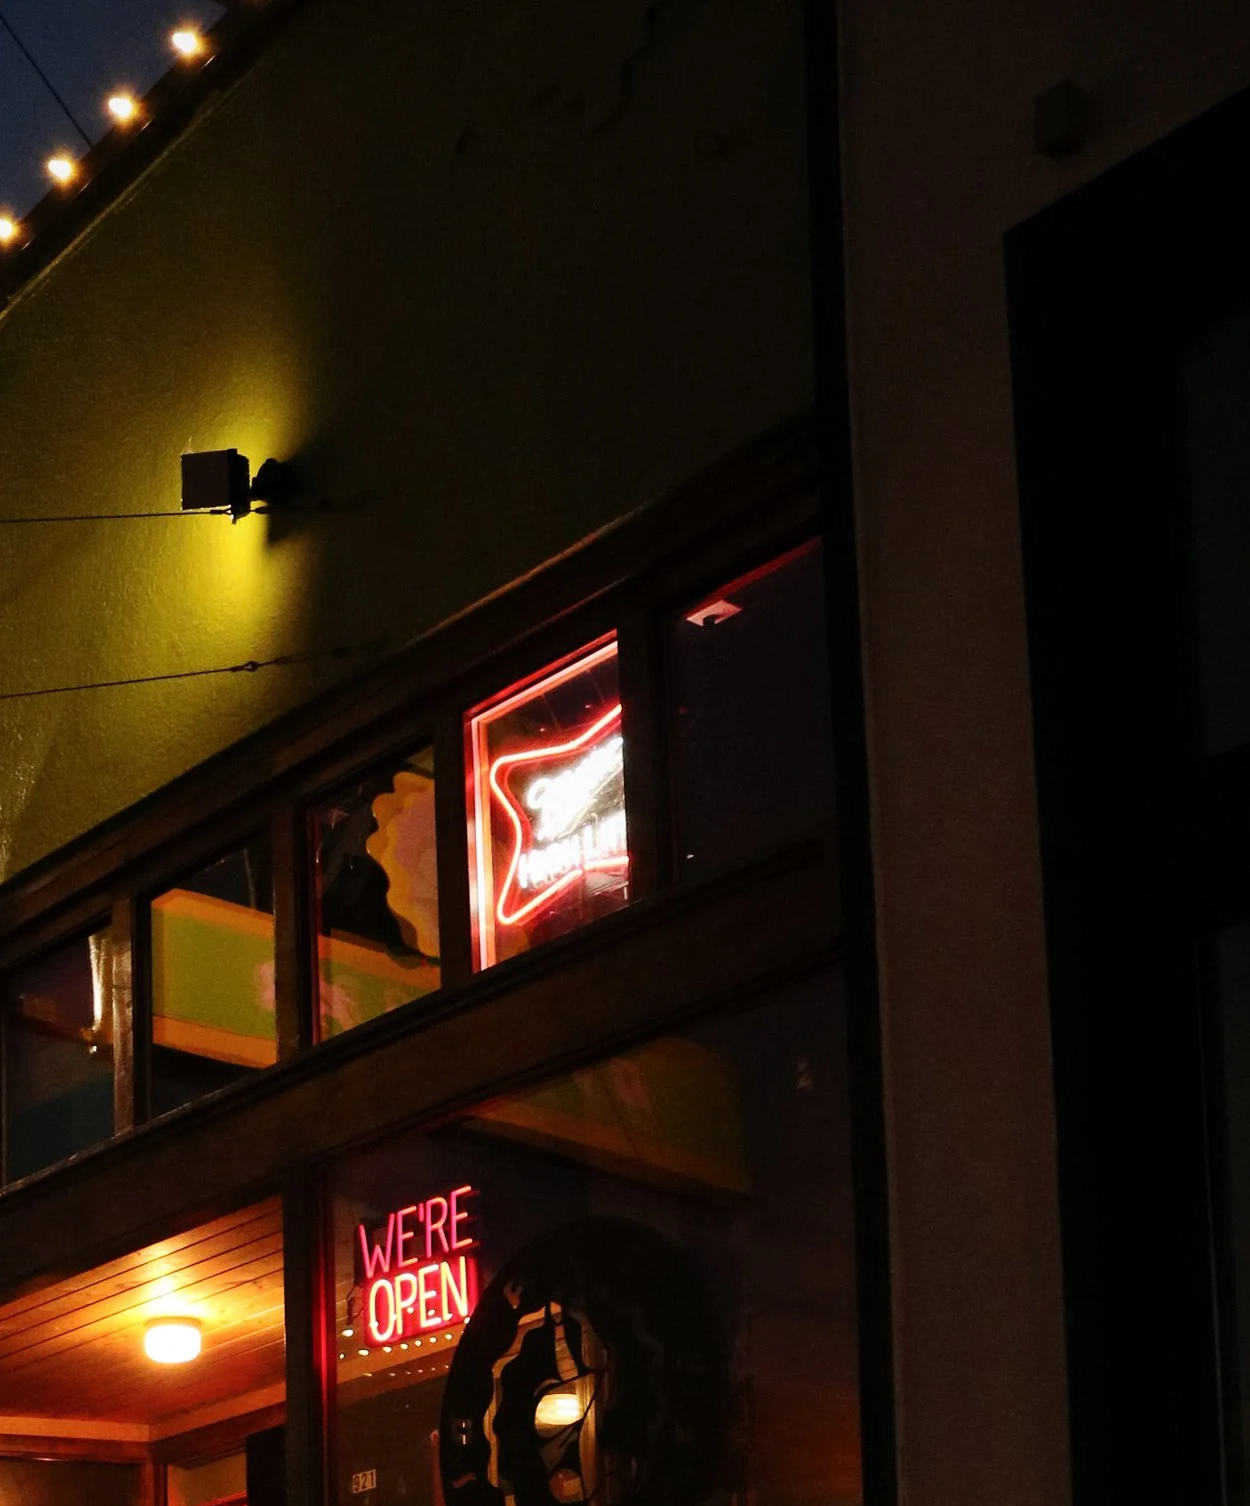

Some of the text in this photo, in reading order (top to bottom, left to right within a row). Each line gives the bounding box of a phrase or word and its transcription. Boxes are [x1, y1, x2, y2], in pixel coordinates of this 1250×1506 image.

[359, 1185, 473, 1279] WE'RE
[369, 1256, 469, 1342] OPEN
[353, 1470, 375, 1492] 921
